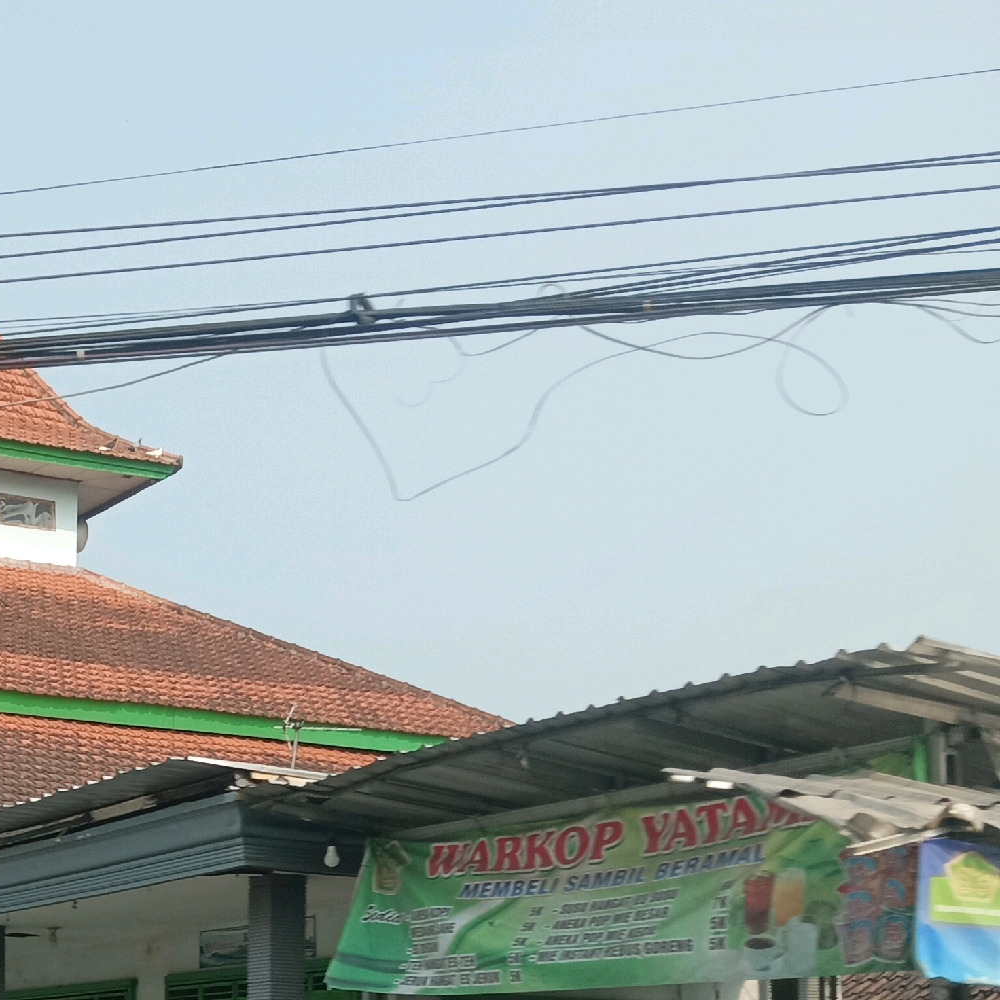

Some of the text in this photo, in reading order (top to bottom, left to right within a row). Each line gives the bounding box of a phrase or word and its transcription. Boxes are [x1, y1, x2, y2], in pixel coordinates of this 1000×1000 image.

[427, 820, 624, 878] WARKOP
[457, 843, 764, 899] MEMBELI SAMBIL BERAMAL
